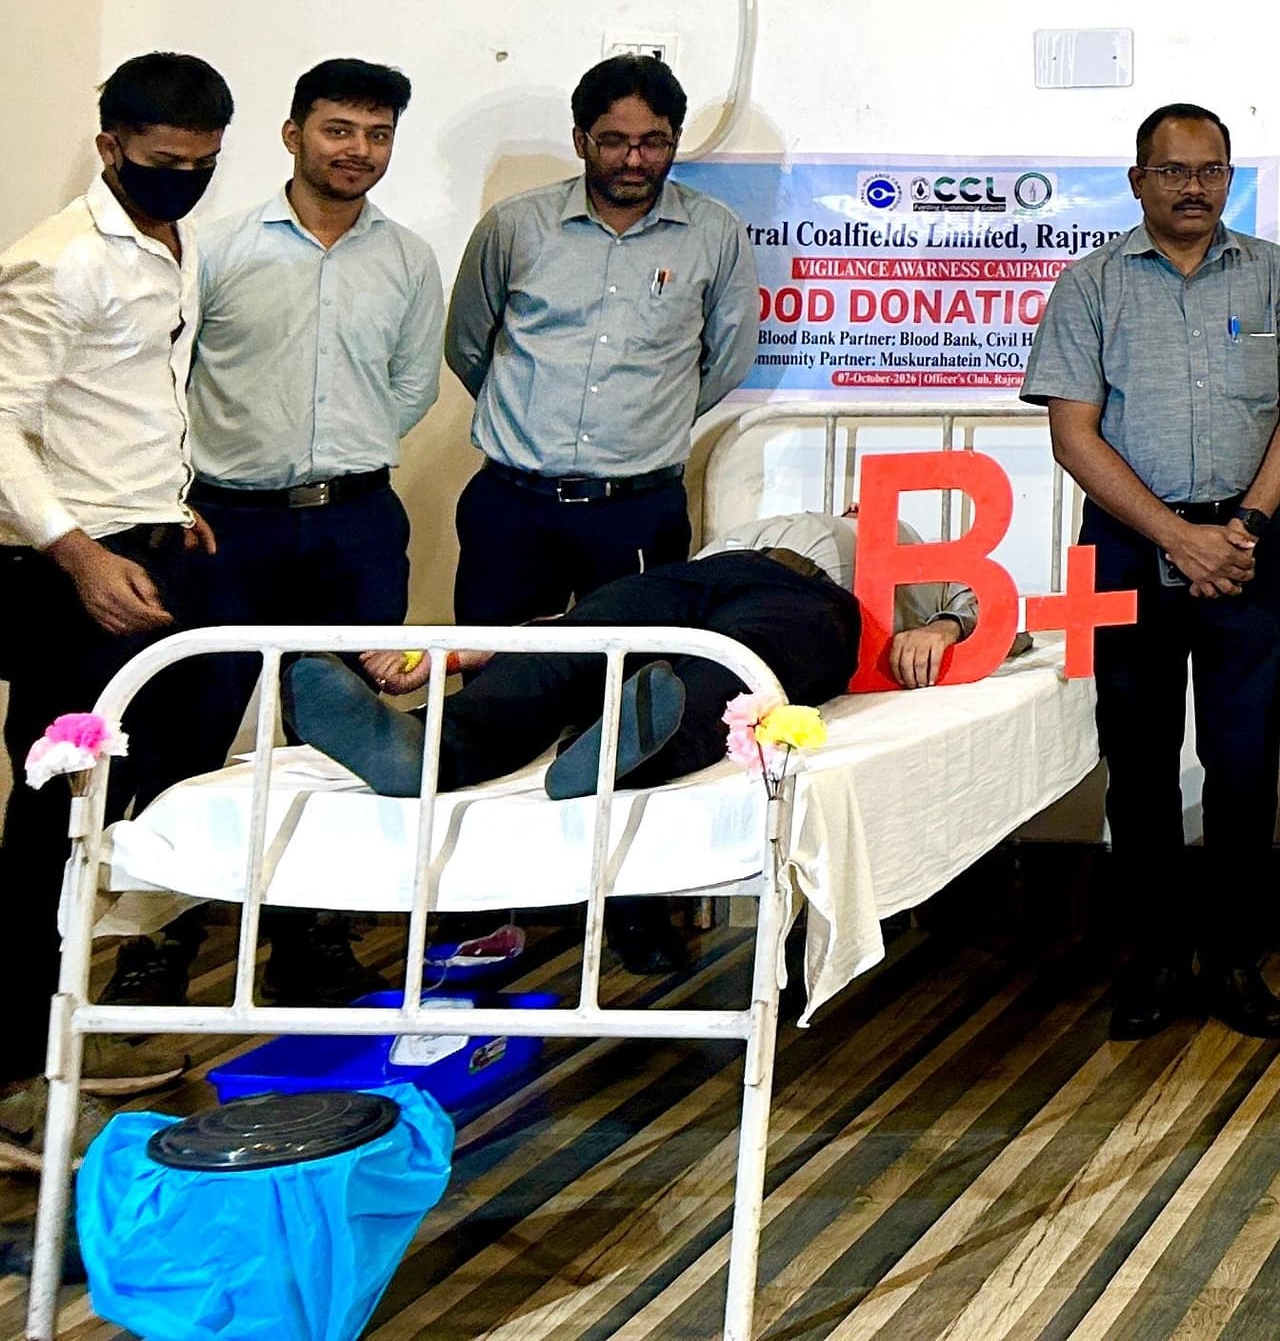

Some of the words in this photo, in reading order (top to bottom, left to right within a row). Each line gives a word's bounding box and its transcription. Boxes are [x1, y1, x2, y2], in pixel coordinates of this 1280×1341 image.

[934, 176, 1006, 202] CCL
[747, 221, 788, 246] tral
[797, 221, 918, 247] Coalfields
[799, 260, 889, 277] VIGILANCE
[892, 260, 980, 278] AWARNESS
[983, 261, 1066, 278] CAMPAIG
[850, 289, 1046, 324] DONATIO
[758, 330, 797, 345] Blood
[801, 330, 835, 345] Bank
[840, 331, 896, 346] Partner:
[900, 331, 939, 346] Blood
[943, 331, 983, 349] Bank,
[986, 331, 1017, 347] Civil
[754, 351, 816, 369] mmunity
[820, 351, 876, 366] Partner:
[880, 352, 981, 367] Muskurahatein
[985, 353, 1024, 369] NGO,
[848, 450, 1138, 694] B+
